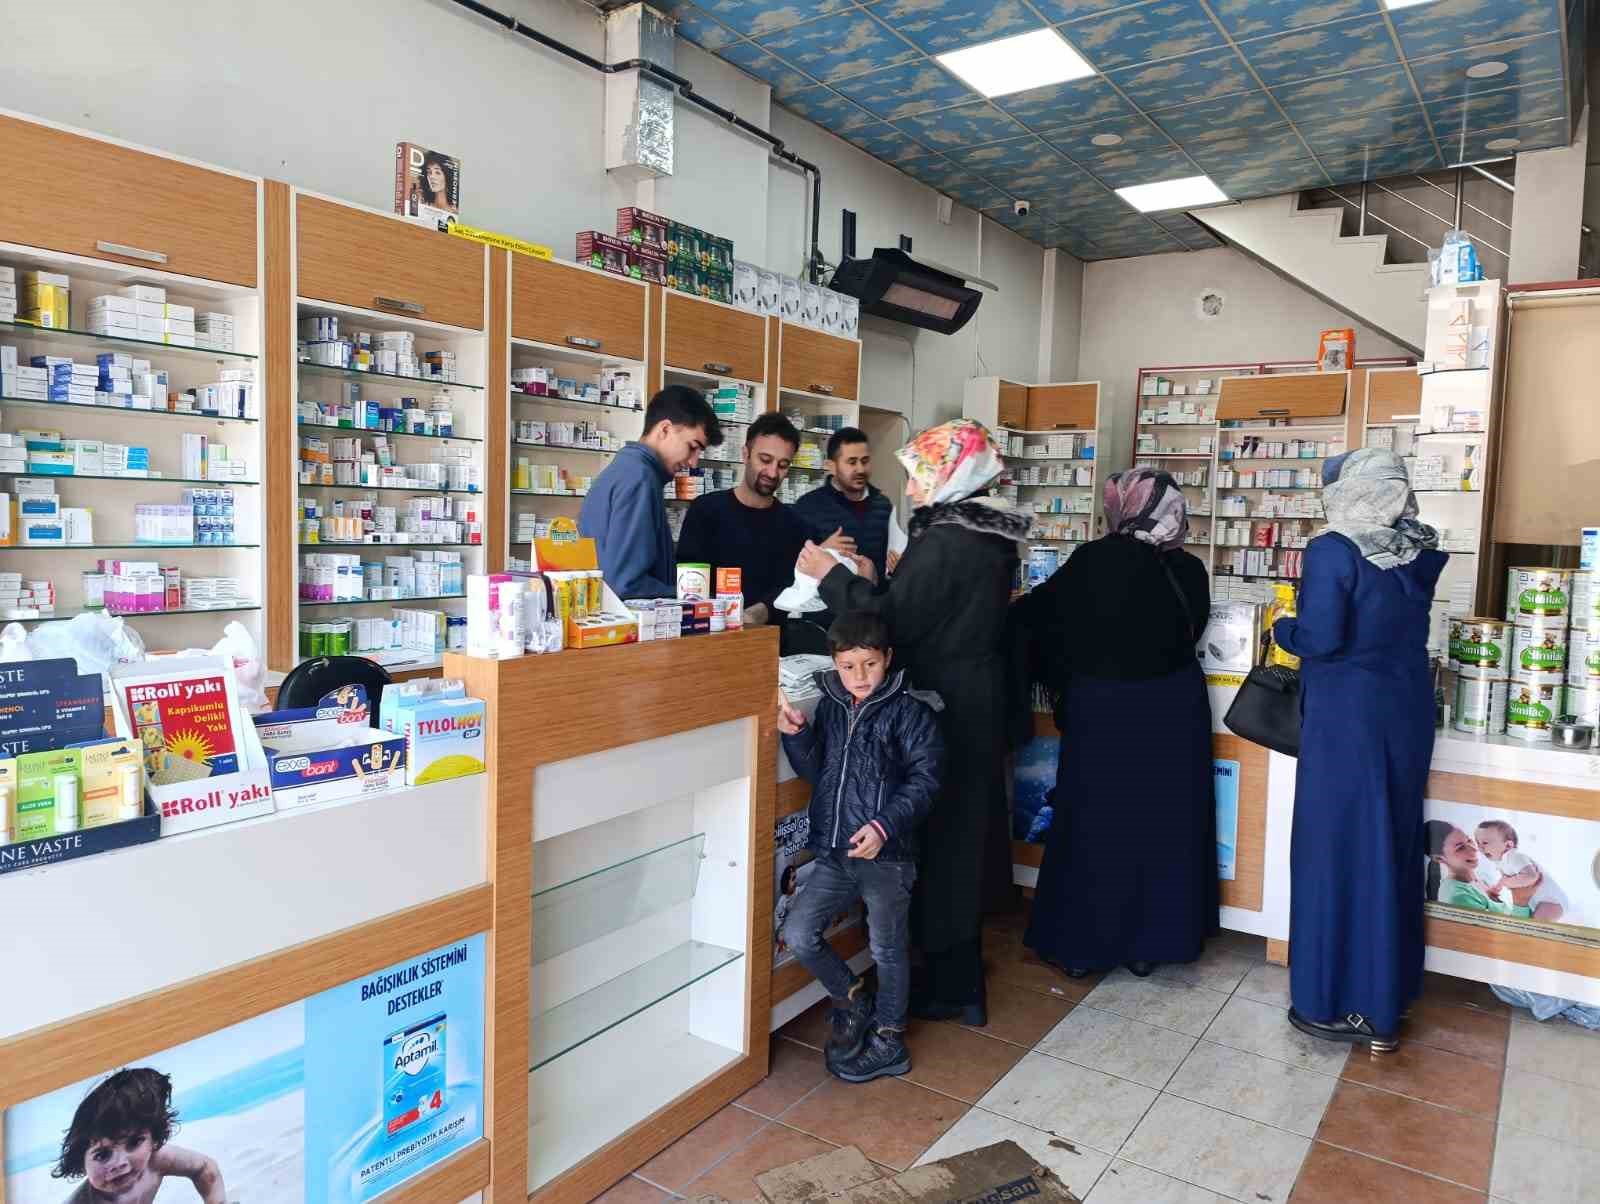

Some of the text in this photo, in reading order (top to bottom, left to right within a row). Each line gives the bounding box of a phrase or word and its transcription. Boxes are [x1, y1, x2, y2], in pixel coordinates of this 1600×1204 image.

[185, 680, 221, 699] yakı
[167, 701, 225, 716] Kapsikumlu
[194, 712, 225, 723] Delikli
[207, 723, 228, 733] Yakı
[228, 783, 270, 809] yakı
[31, 834, 83, 856] VASTE
[361, 943, 468, 1002] BAĞIŞIKLIK SİSTEMİNİ
[387, 980, 443, 1017] DESTEKLER
[394, 1039, 437, 1070] Aptamil
[429, 1088, 442, 1110] 4
